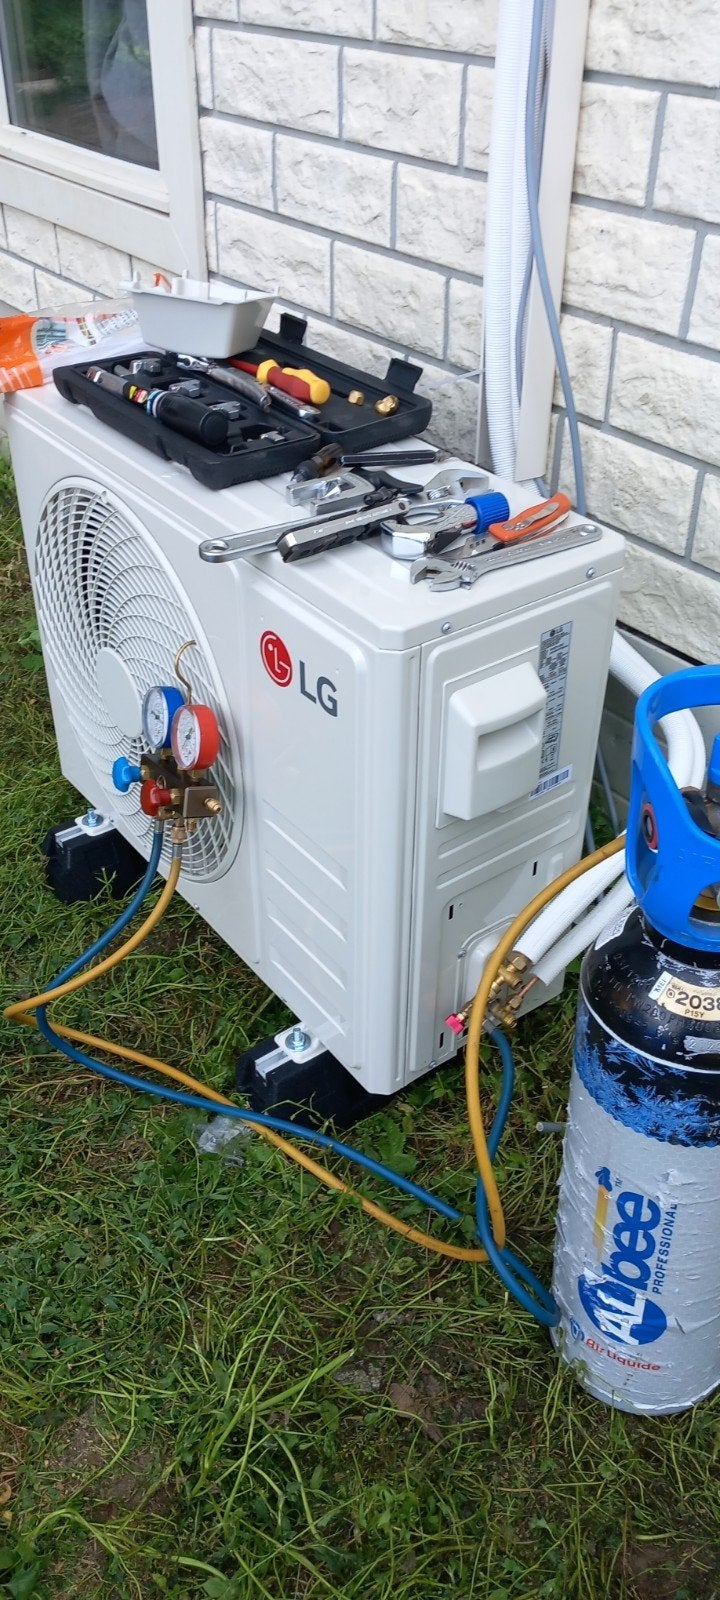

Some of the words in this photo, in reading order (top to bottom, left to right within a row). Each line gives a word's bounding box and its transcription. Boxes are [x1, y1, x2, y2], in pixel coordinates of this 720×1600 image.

[299, 660, 338, 717] LG
[685, 1008, 705, 1018] P15Y
[585, 1338, 605, 1353] Air
